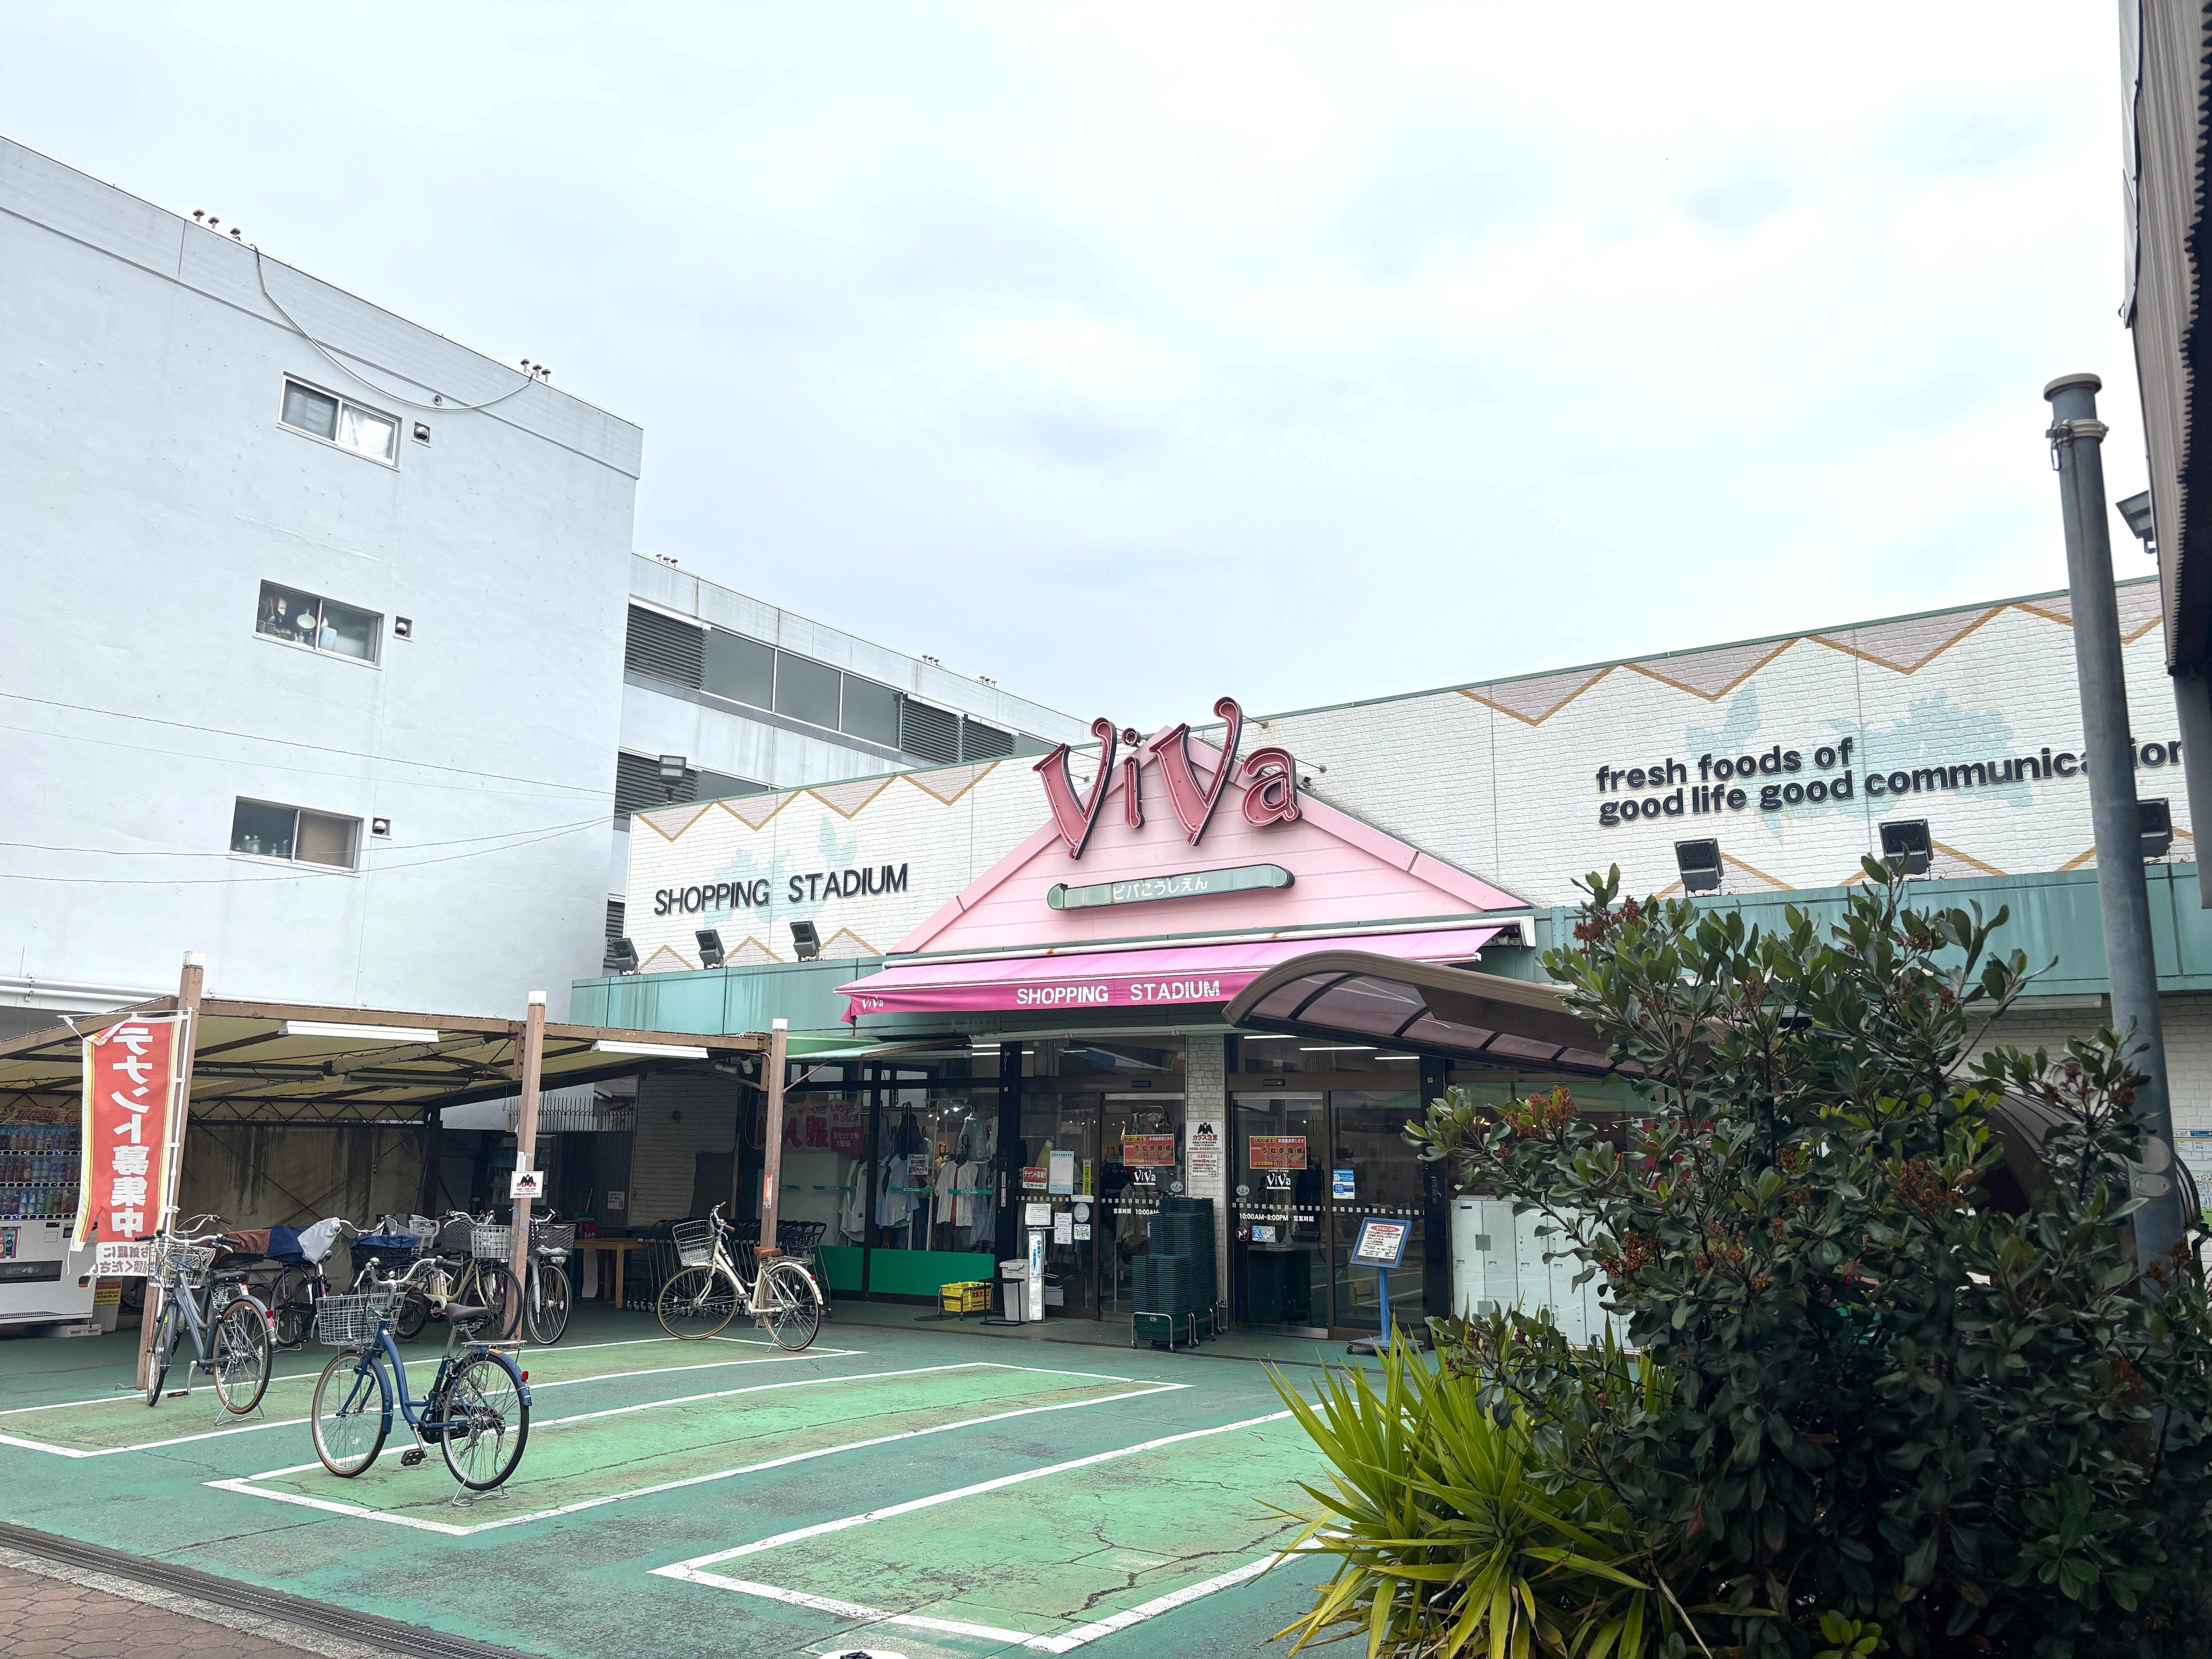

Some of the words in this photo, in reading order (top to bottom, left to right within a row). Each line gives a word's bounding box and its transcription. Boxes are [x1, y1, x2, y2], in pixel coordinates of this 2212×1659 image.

[1596, 758, 1686, 792] fresh
[1698, 745, 1802, 781] foods
[1814, 737, 1854, 768] of
[1032, 697, 1302, 860] ViVa
[1599, 788, 1684, 826] good
[1692, 784, 1748, 814] life
[1759, 770, 1855, 811] good
[654, 879, 771, 916] SHOPPING
[788, 863, 908, 903] STADIUM
[1113, 877, 1208, 901] ビバこうしえん
[861, 995, 884, 1009] ViVa
[1016, 985, 1109, 1005] SHOPPING
[1130, 980, 1219, 1000] STADIUM
[1134, 1170, 1156, 1182] ViVa
[1266, 1173, 1291, 1187] ViVa
